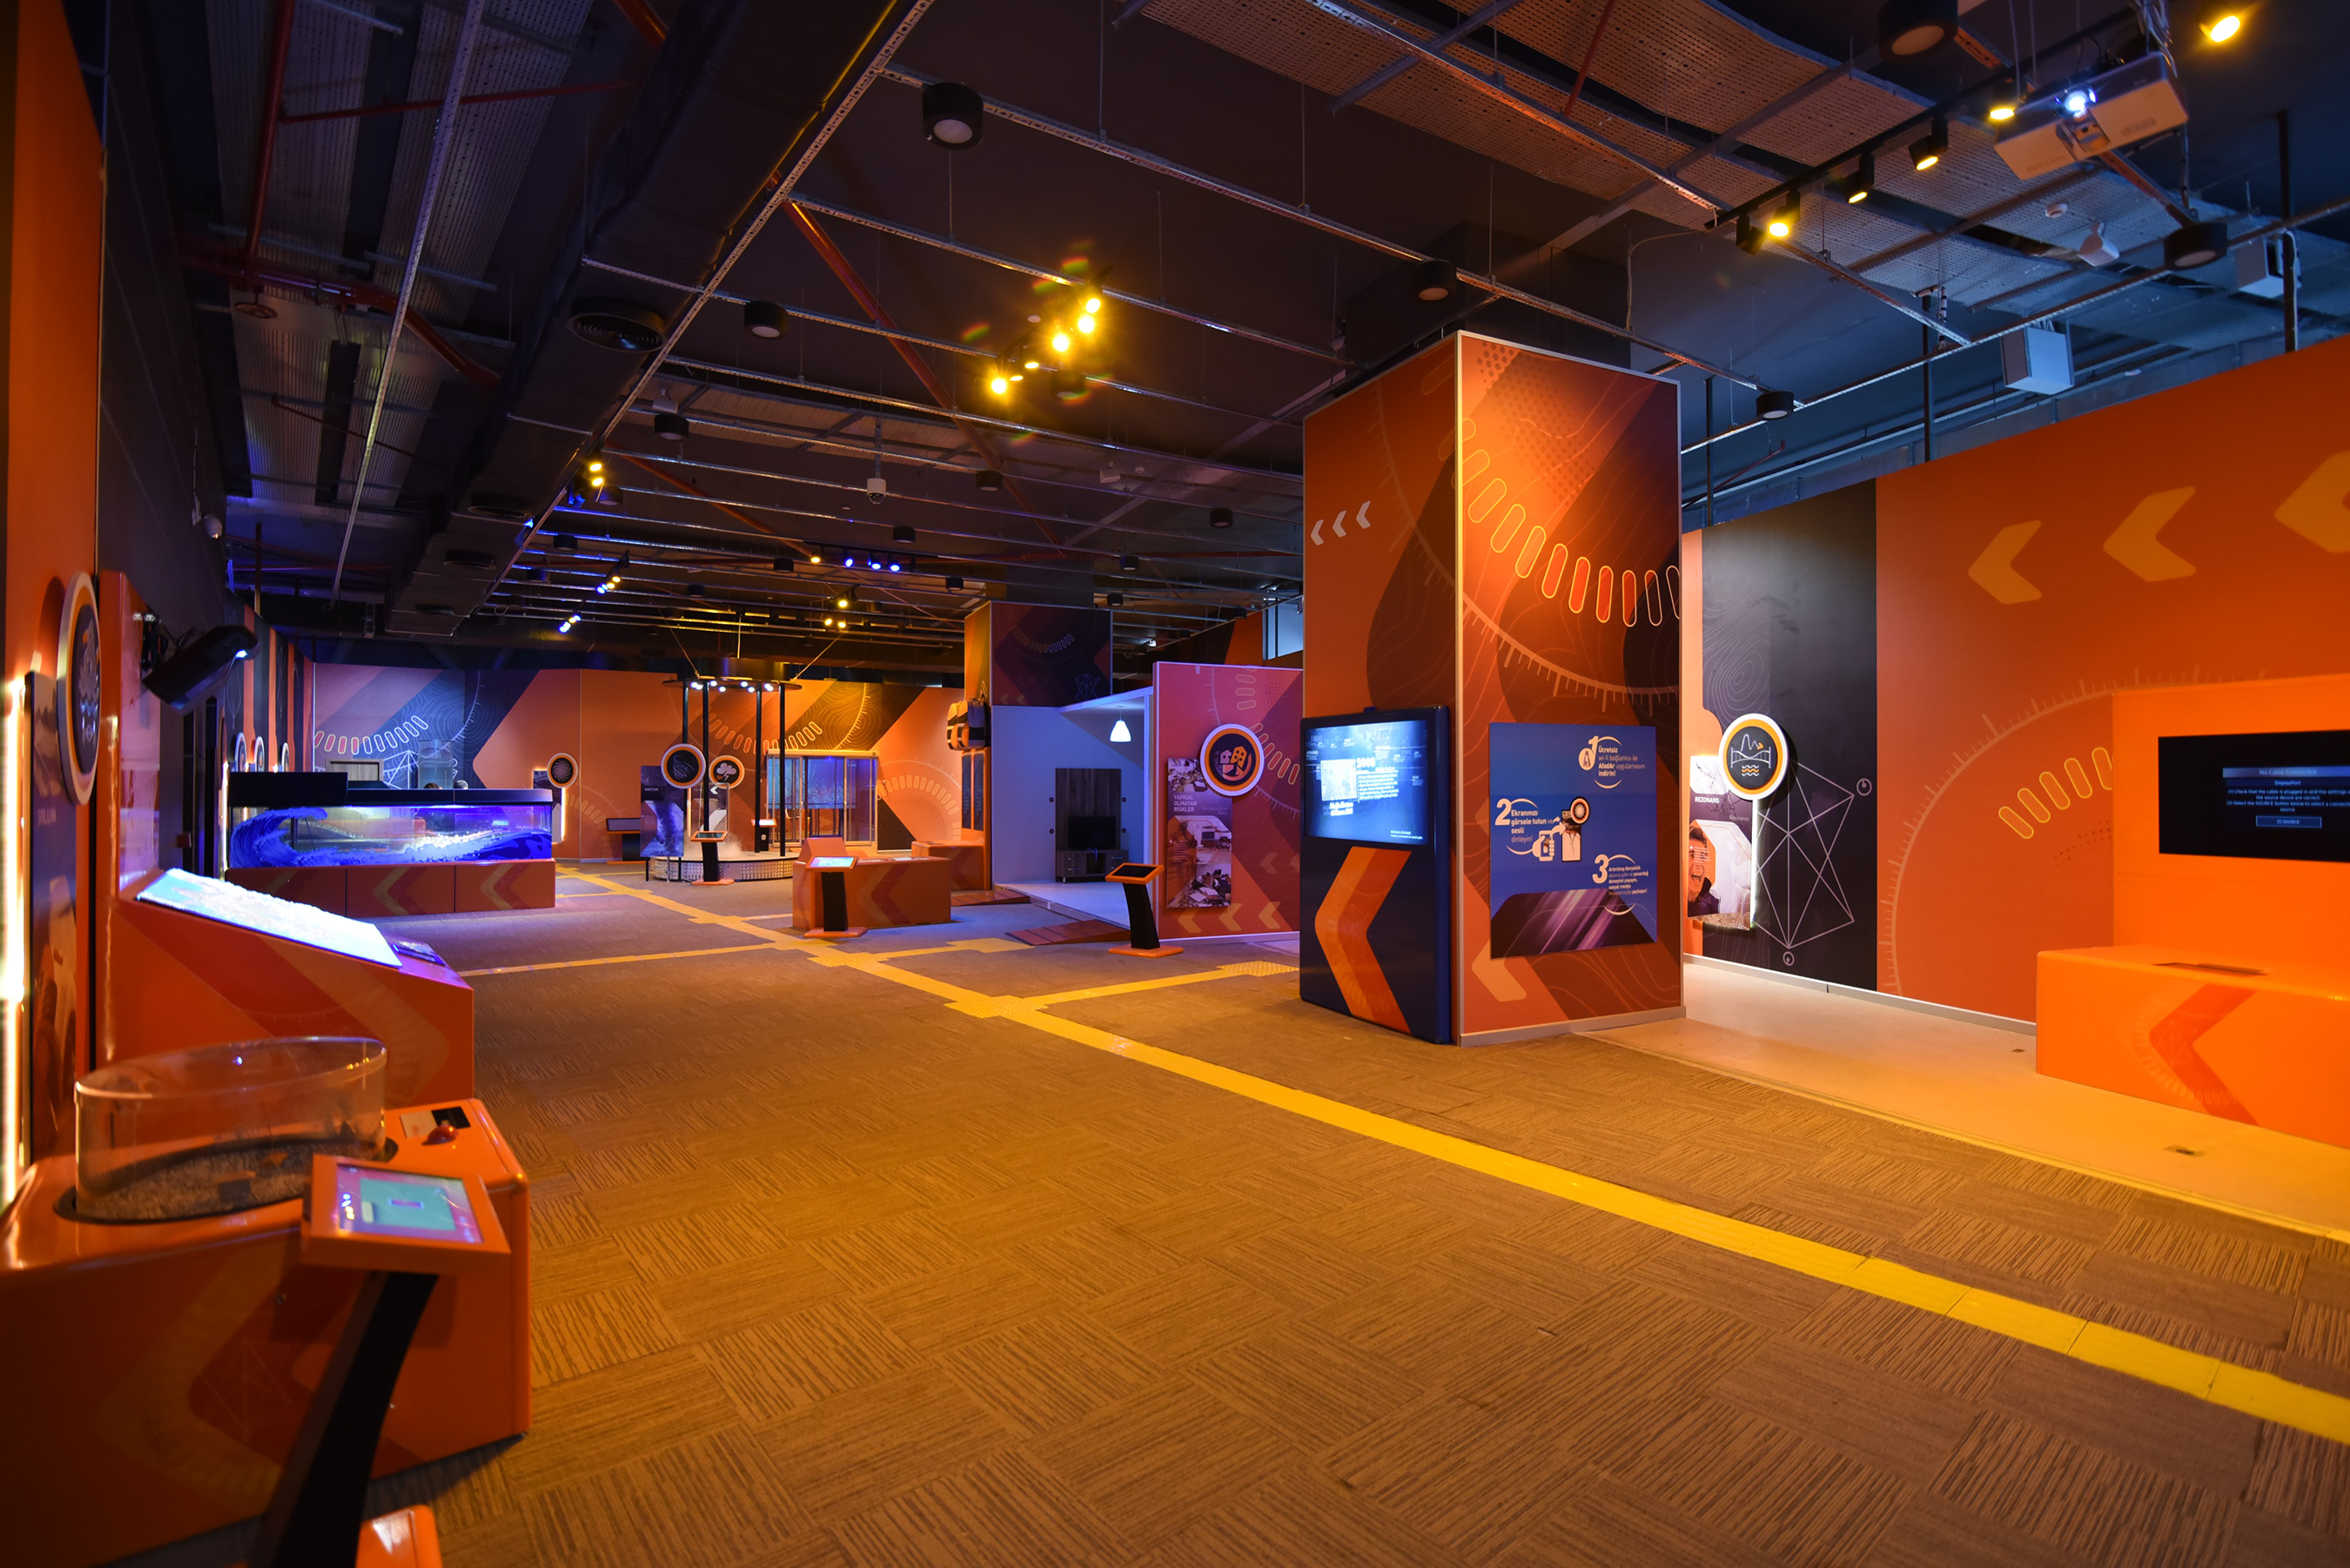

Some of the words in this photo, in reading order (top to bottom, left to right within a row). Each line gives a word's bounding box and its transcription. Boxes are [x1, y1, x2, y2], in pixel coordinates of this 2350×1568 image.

[1598, 745, 1618, 754] Ücretsiz
[1694, 795, 1720, 804] REZONANS
[1494, 798, 1512, 826] 2
[1511, 818, 1532, 828] görsele
[1511, 835, 1533, 844] dinleyin!
[1592, 854, 1609, 884] 3
